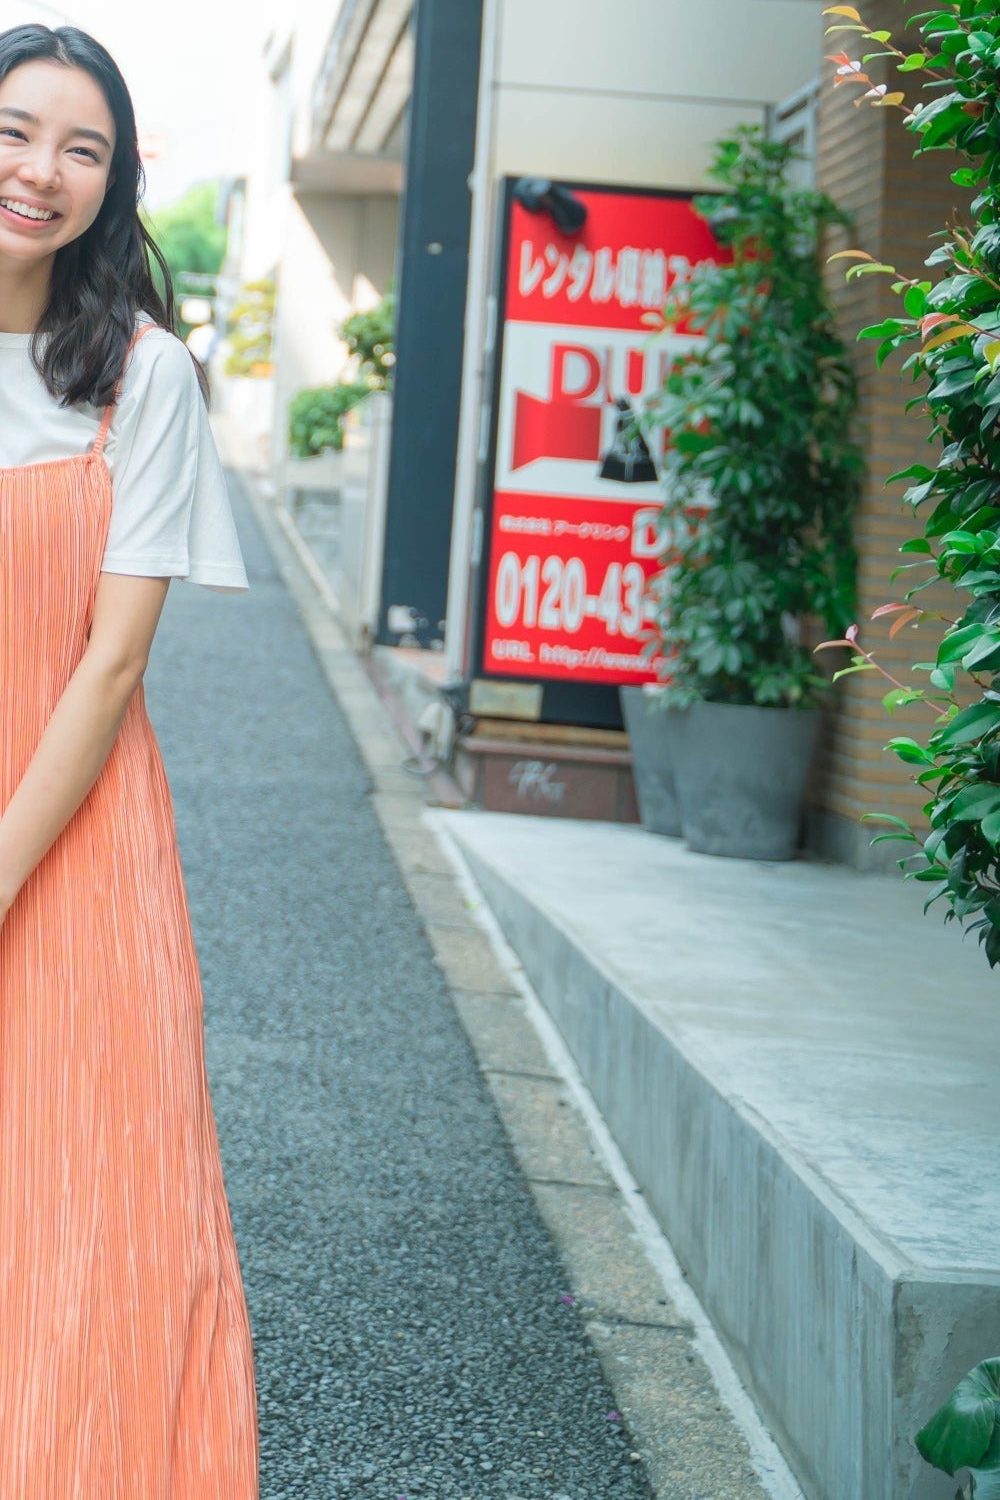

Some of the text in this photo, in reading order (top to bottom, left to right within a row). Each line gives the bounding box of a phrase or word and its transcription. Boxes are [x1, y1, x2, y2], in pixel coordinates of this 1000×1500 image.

[519, 240, 718, 308] レンタル収納ス
[551, 343, 668, 407] DU
